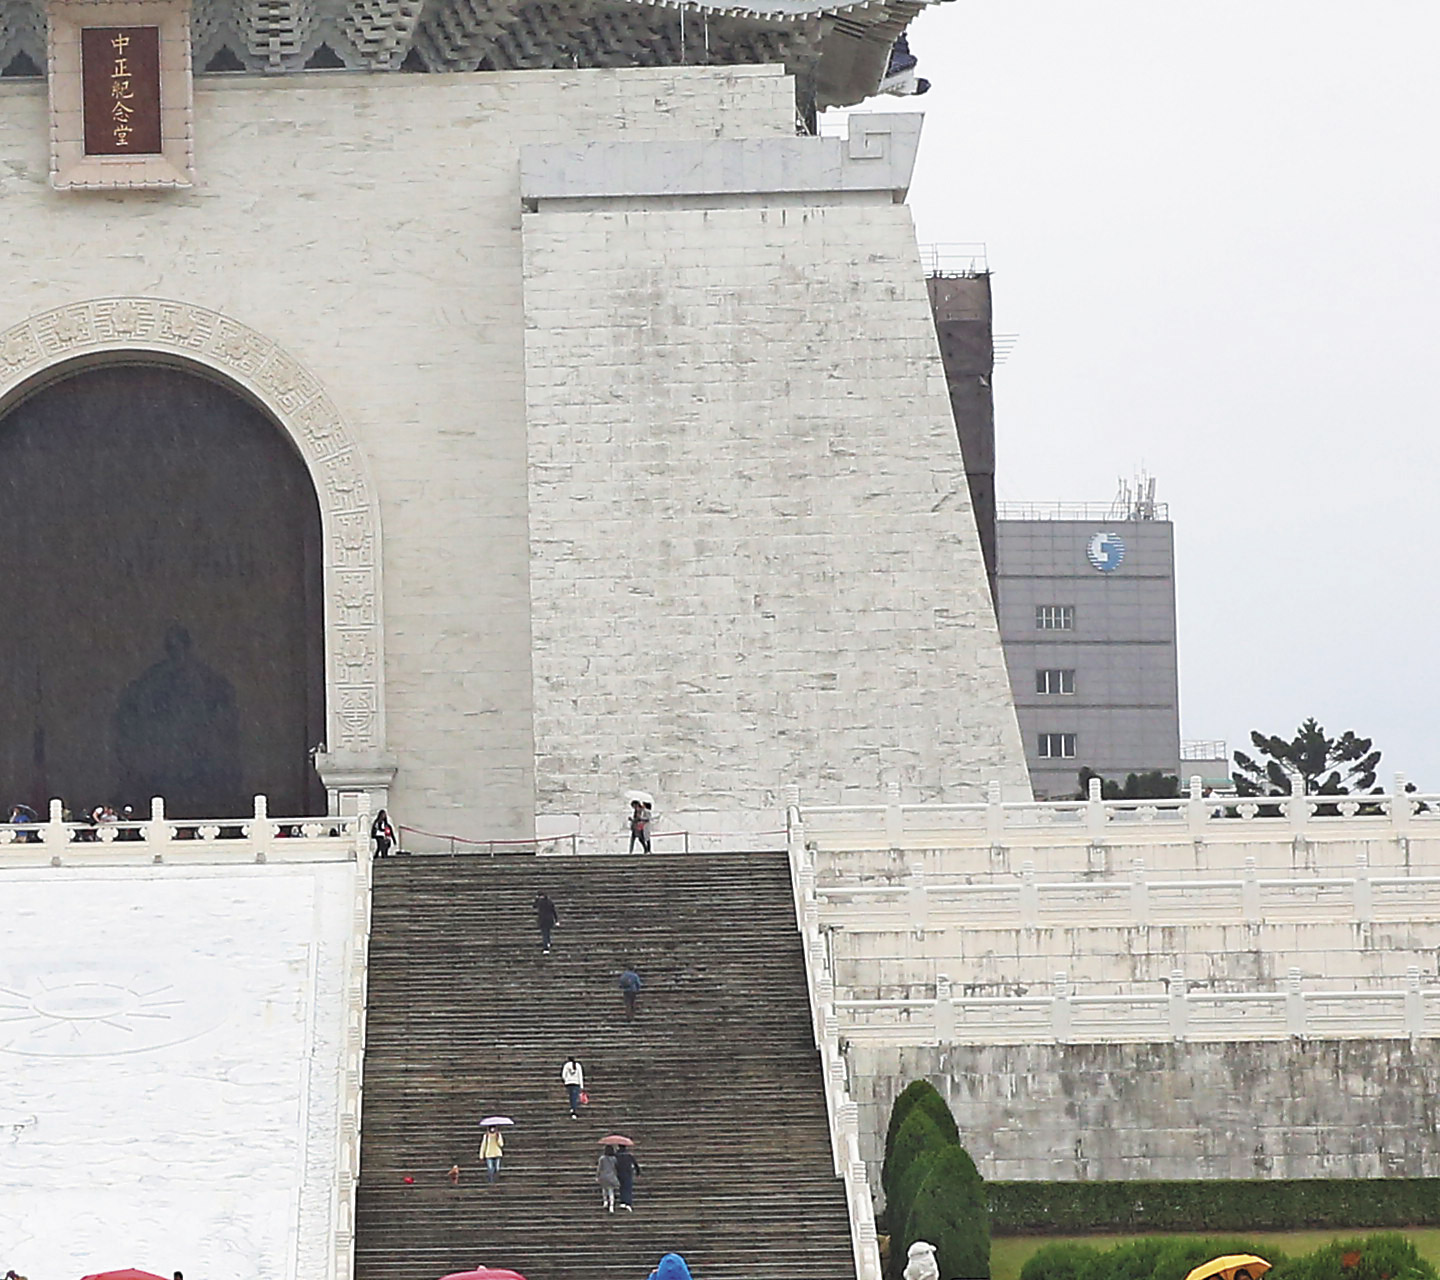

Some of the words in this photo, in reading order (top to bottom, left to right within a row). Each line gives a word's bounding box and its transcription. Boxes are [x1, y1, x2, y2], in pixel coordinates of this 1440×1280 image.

[110, 33, 134, 146] 中正紀念堂
